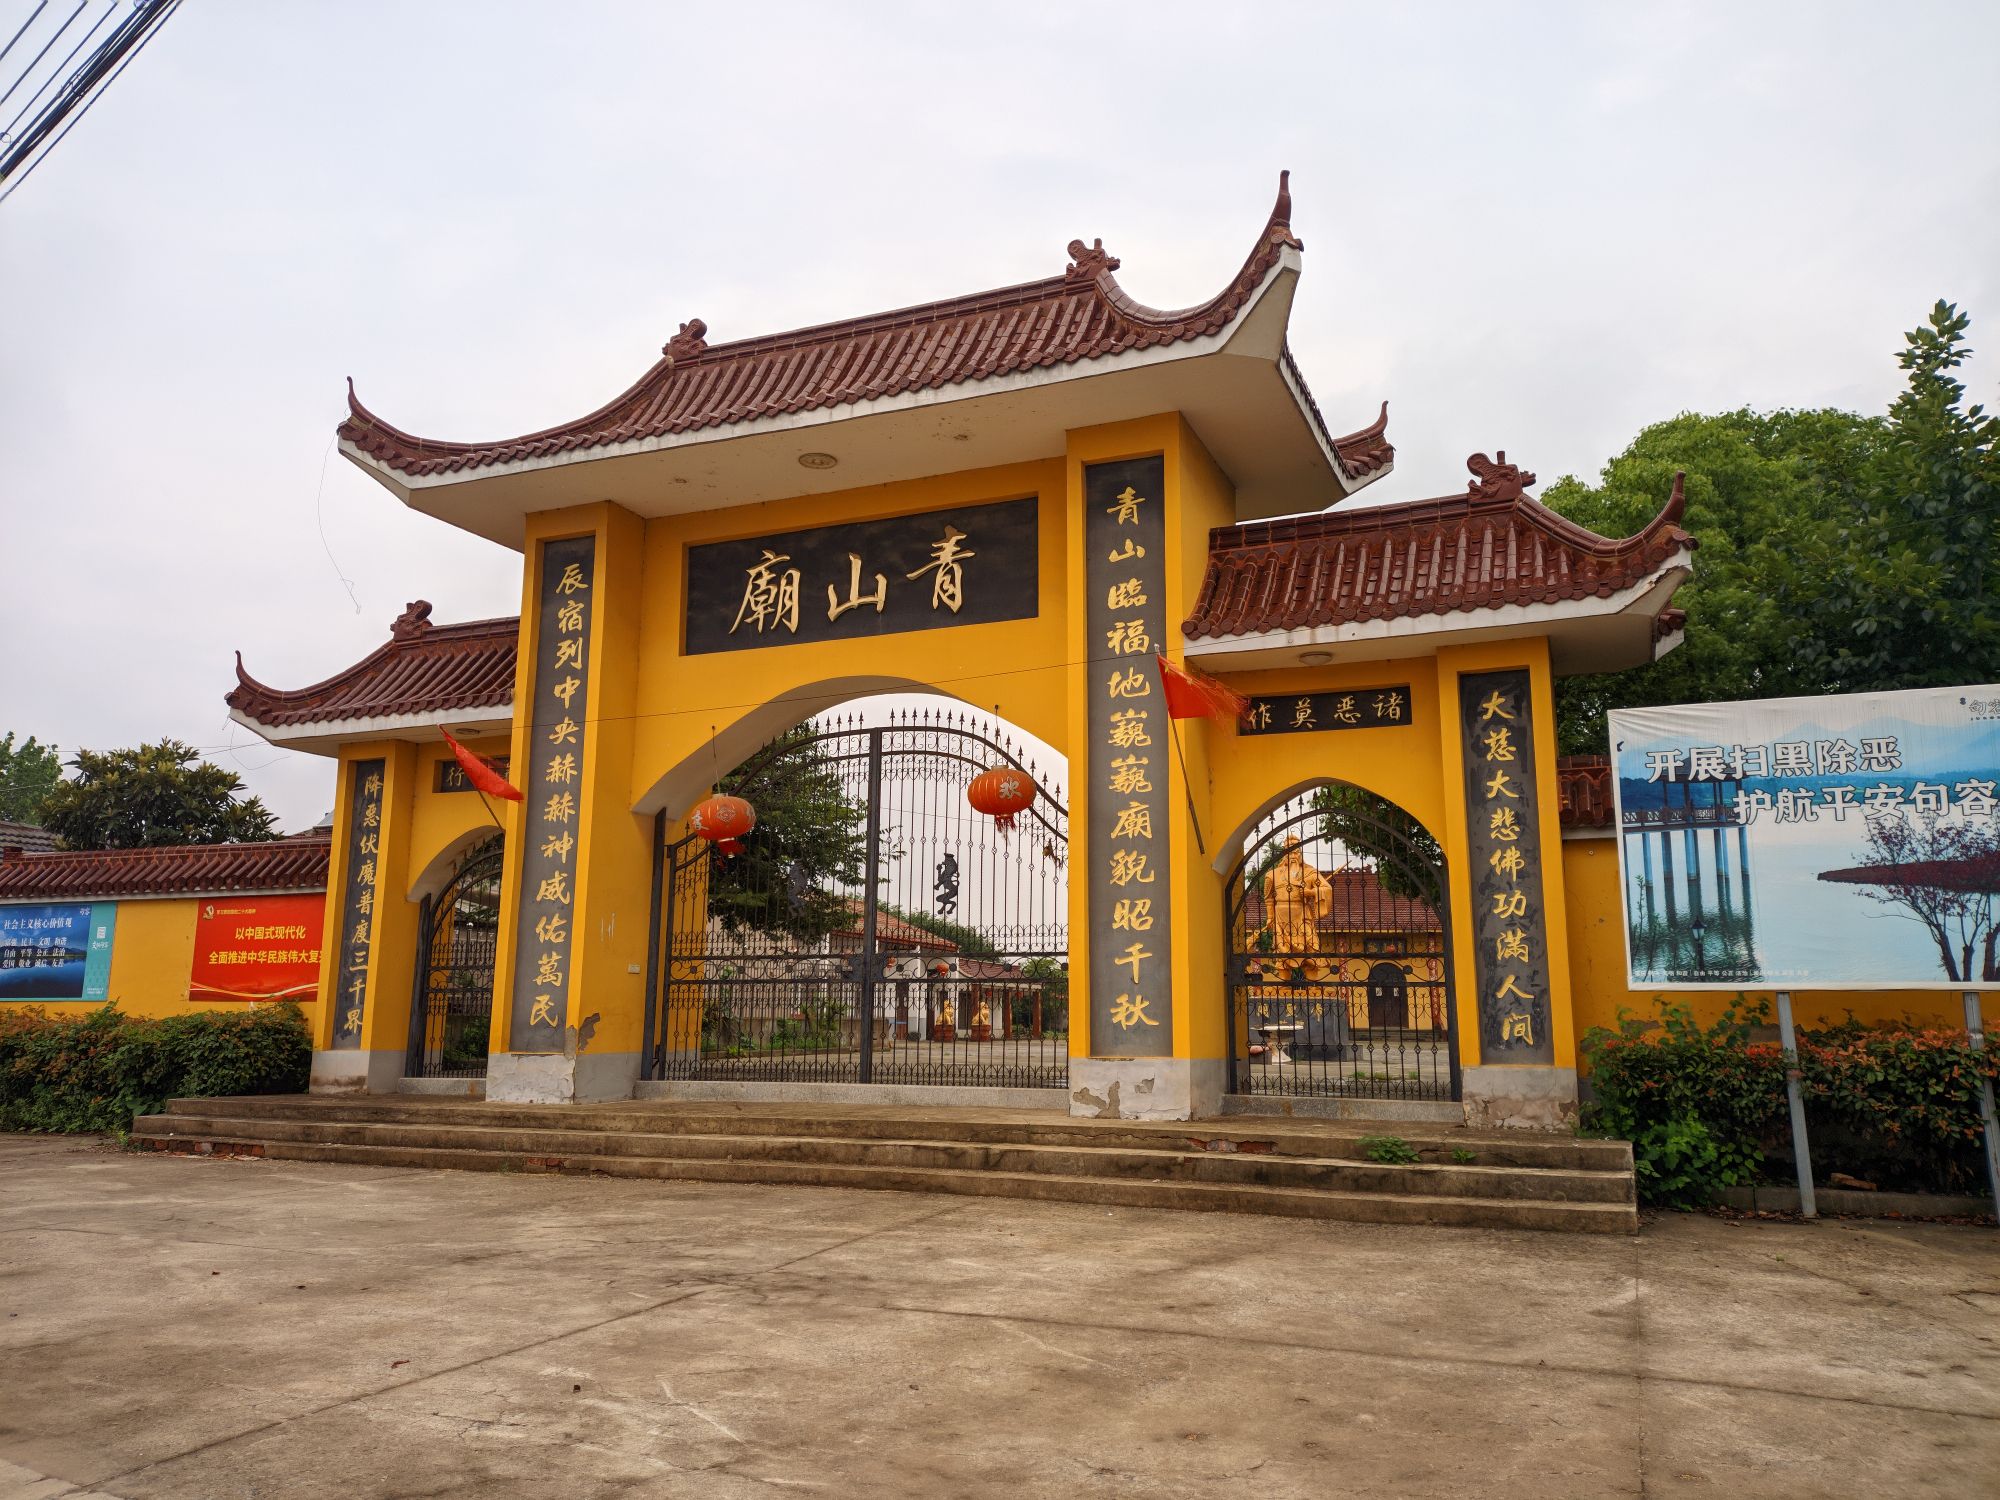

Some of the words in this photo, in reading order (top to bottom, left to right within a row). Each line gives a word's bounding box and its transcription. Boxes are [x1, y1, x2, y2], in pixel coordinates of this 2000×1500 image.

[727, 525, 976, 634] 青山廟
[1645, 736, 1902, 784] 开展扫黑除恶
[1732, 778, 1999, 826] 护航平安句容
[4, 917, 73, 930] 社会主义核心价值观
[235, 925, 306, 940] 以中国式现代化
